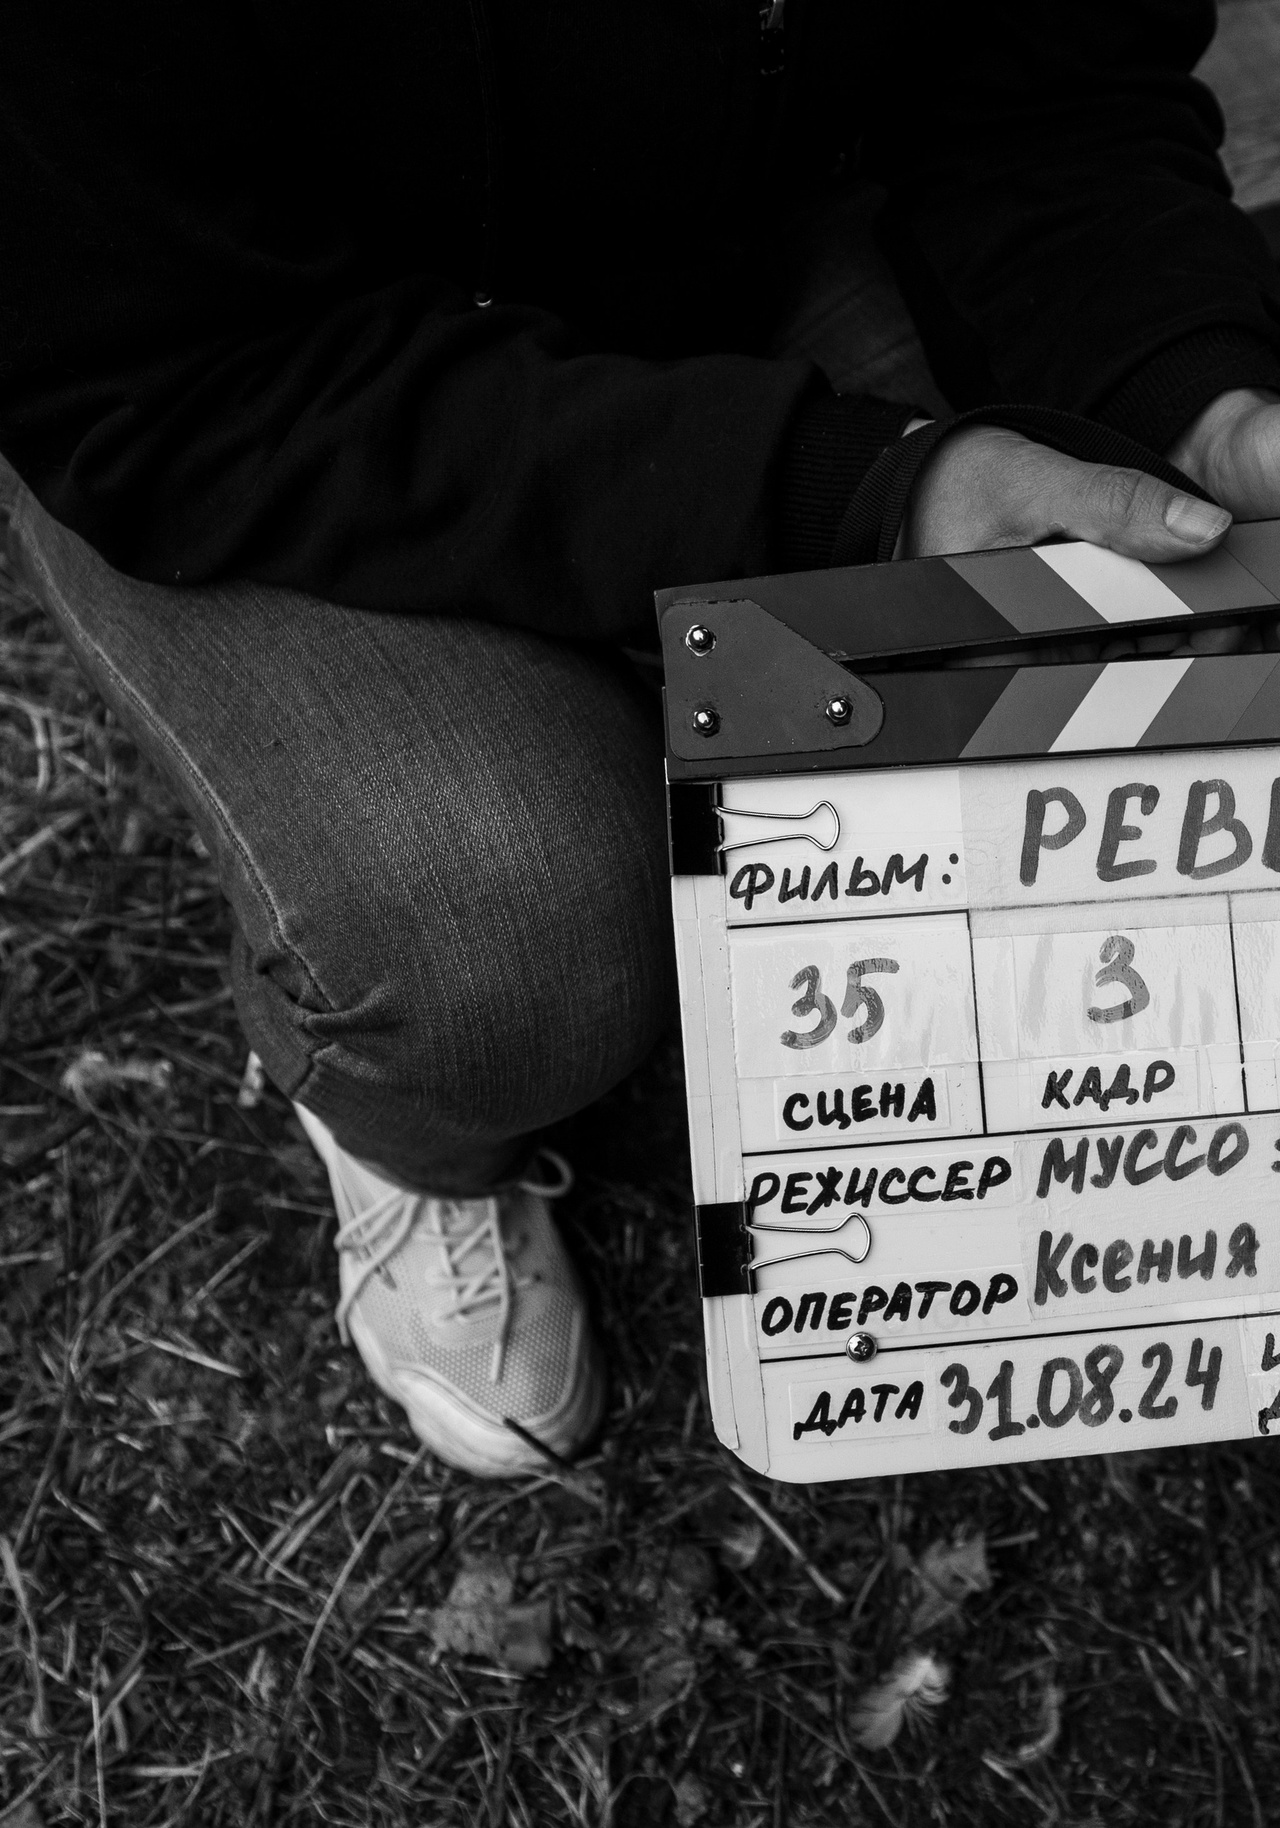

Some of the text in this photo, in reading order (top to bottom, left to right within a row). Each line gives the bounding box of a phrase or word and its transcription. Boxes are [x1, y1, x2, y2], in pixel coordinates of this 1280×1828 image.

[729, 852, 959, 909] ФИЛЬМ:
[780, 958, 900, 1049] 35
[1087, 935, 1150, 1024] 3
[783, 1078, 937, 1131] СЦЕНА
[1041, 1060, 1175, 1111] КАДР
[749, 1156, 1012, 1215] РЕЖИССЕР
[1037, 1122, 1249, 1199] МУССО
[760, 1273, 1019, 1336] ОПЕРАТОР
[793, 1338, 1222, 1441] ДАТА 31.08.24
